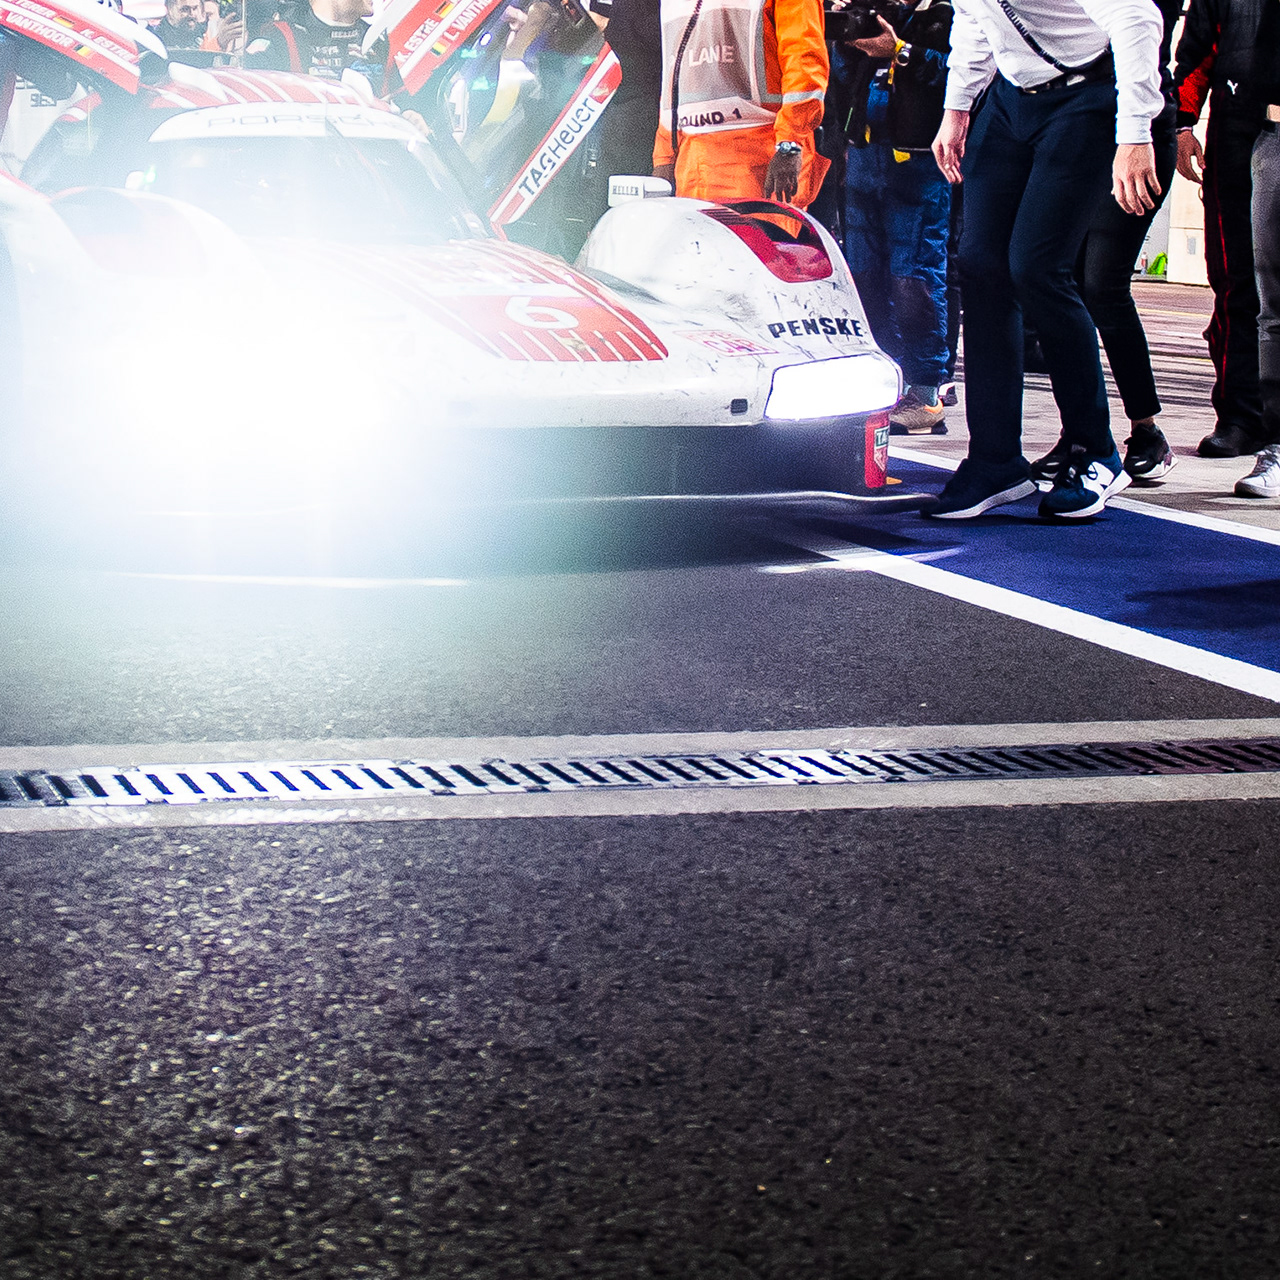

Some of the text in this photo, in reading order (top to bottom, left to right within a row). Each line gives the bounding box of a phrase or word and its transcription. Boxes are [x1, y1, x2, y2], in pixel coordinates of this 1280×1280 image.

[3, 10, 75, 48] VANTHOOR
[688, 44, 735, 68] LANE
[679, 107, 743, 128] OUND 1
[504, 296, 580, 330] 6
[767, 317, 865, 338] PENSKE
